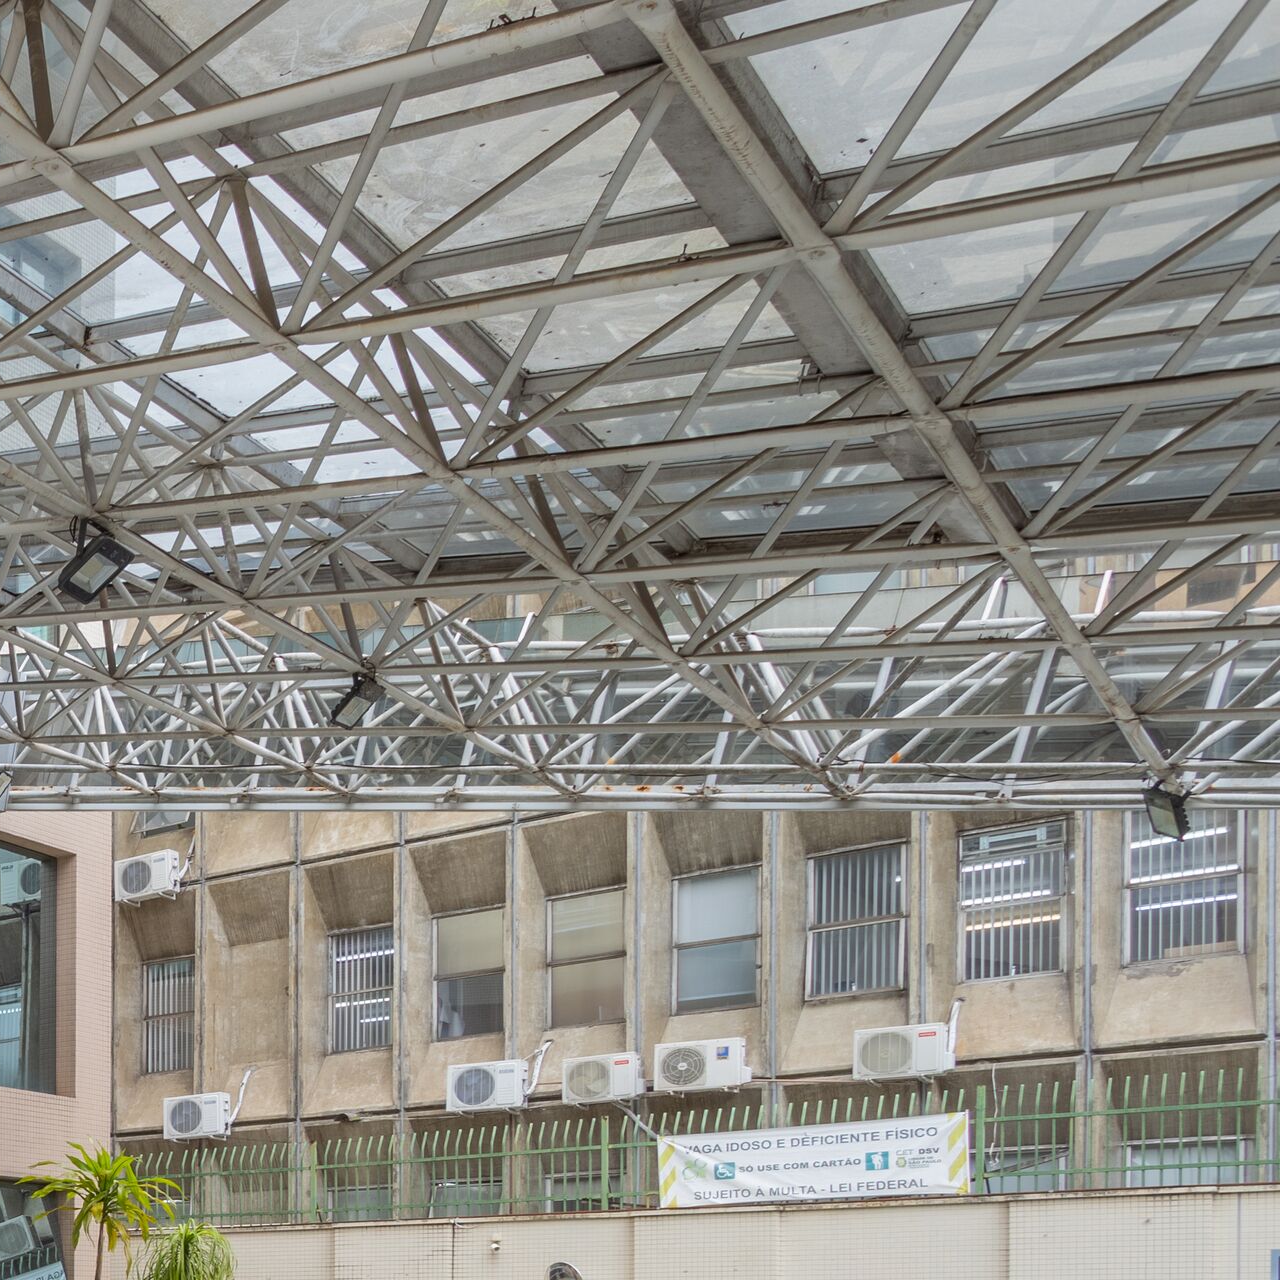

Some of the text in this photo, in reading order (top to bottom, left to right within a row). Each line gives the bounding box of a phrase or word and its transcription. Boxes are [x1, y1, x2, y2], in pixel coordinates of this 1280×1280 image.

[726, 1139, 772, 1152] IDOSO
[776, 1138, 785, 1149] E
[790, 1131, 880, 1148] DEFICIENTE
[886, 1127, 938, 1141] FÍSICO
[739, 1158, 862, 1173] SÓ USE COM CARTÃO
[694, 1187, 751, 1200] SUJEITO
[769, 1185, 817, 1196] MULTA
[829, 1182, 852, 1193] LEI
[857, 1178, 928, 1192] FEDERAL
